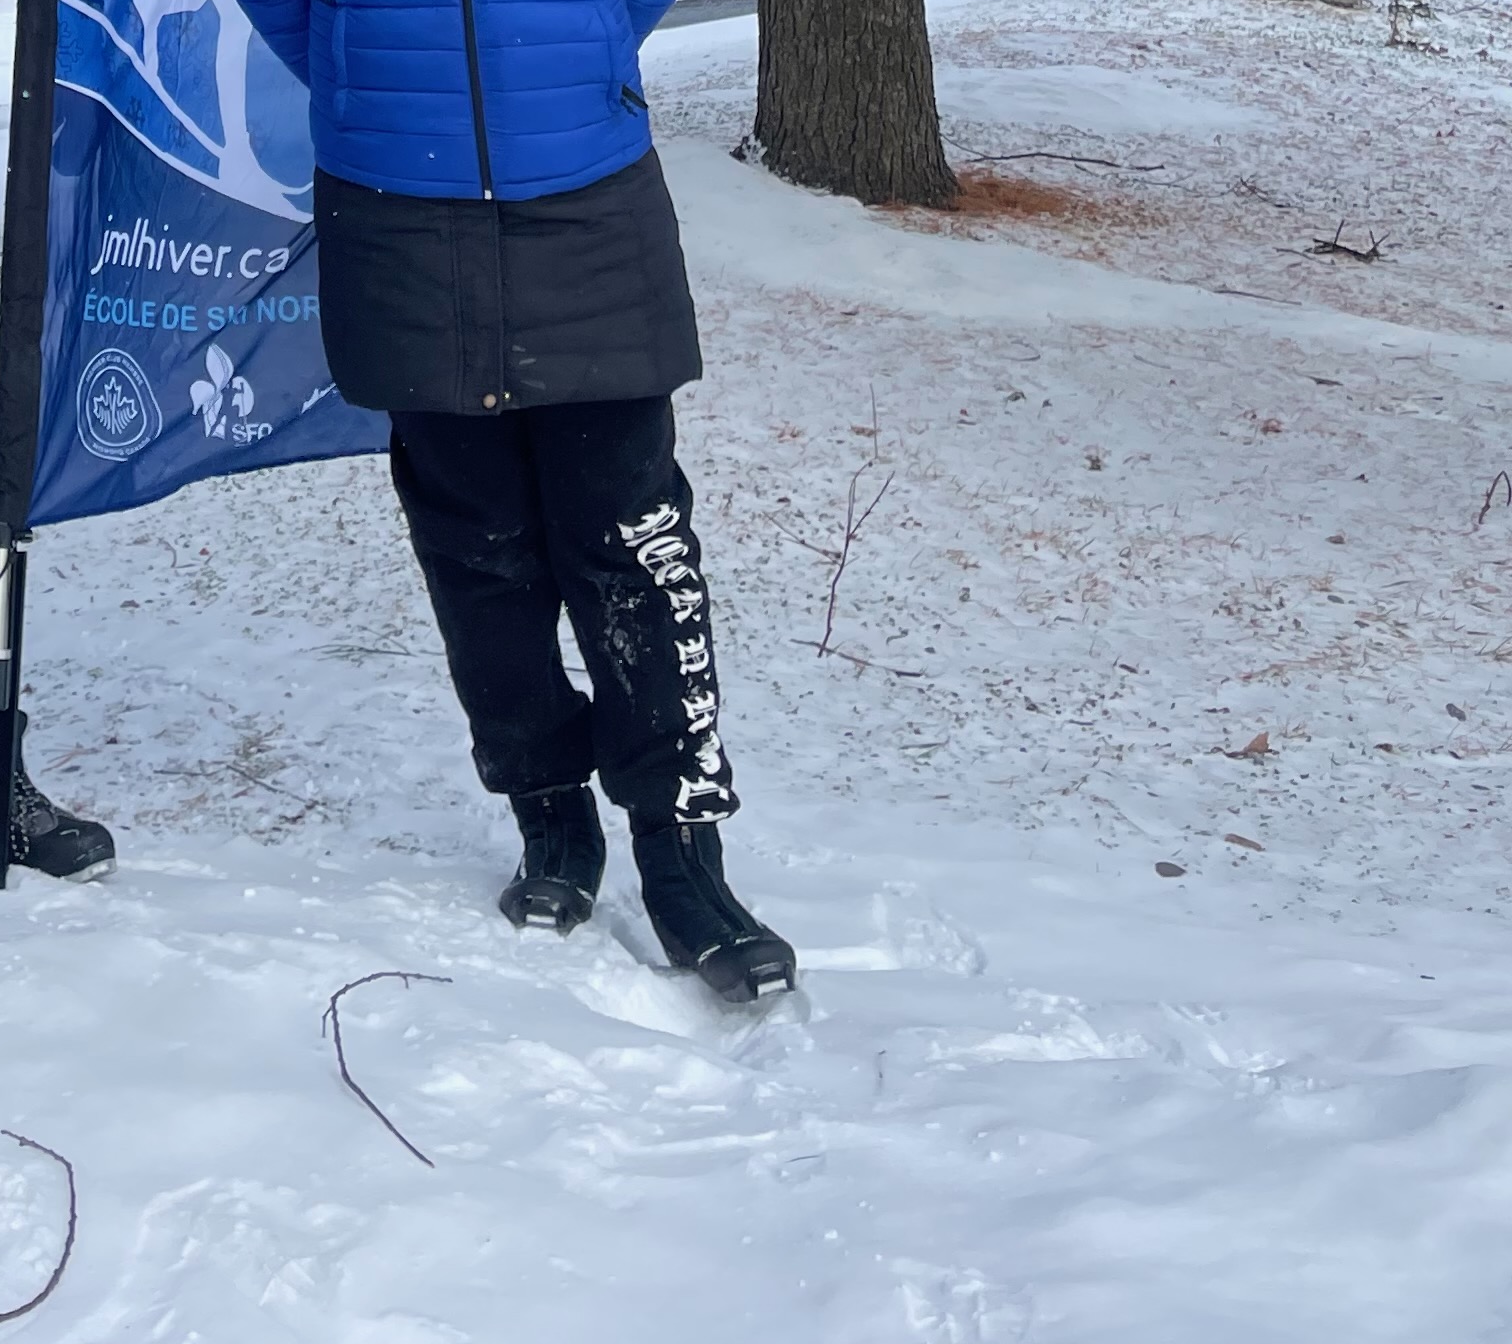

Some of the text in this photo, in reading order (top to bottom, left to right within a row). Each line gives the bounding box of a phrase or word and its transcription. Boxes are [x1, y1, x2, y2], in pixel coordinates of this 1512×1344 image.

[90, 214, 289, 279] jmlhiver.ca
[83, 287, 156, 328] ÉCOLE
[162, 303, 198, 332] DE
[257, 295, 320, 324] NOR
